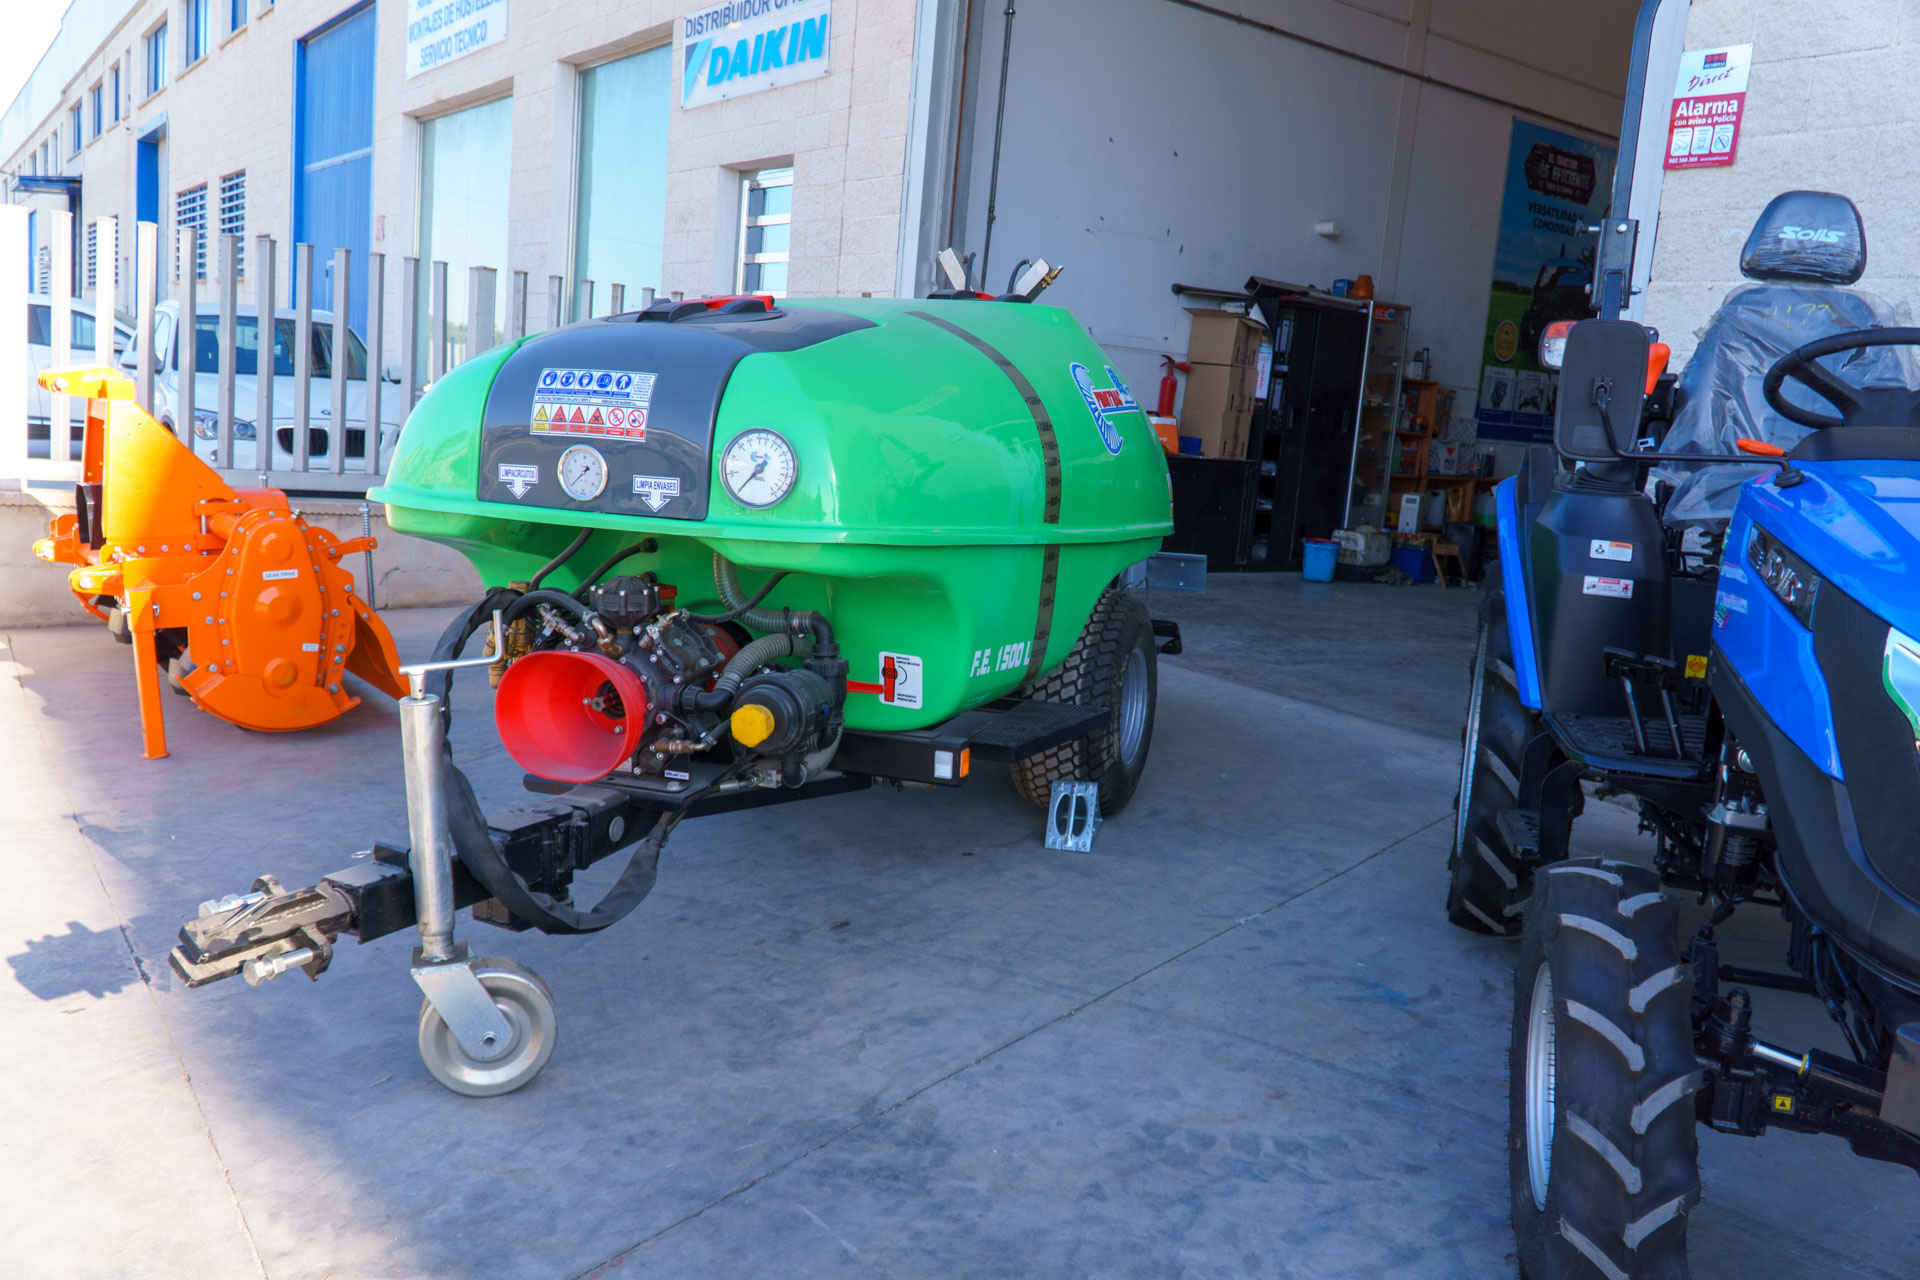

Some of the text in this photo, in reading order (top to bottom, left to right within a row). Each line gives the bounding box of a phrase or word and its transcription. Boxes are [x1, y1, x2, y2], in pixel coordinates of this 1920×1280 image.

[409, 8, 443, 44] MONTAJES
[444, 2, 454, 26] DE
[686, 0, 770, 39] DISTRIBUIDOR
[420, 19, 487, 68] SERVICIO TECNICO
[707, 13, 828, 87] DAIKIN
[1687, 65, 1738, 92] Direct
[1676, 98, 1739, 118] Alarma
[1674, 119, 1687, 127] con
[1688, 116, 1706, 126] aviso
[1528, 201, 1577, 222] VERSATILIDAD
[1533, 218, 1576, 236] COMODIDAD
[502, 468, 535, 479] LIMPIACIRCUITOS
[636, 480, 677, 492] LIMPIA ENVASES
[995, 641, 1025, 672] 1500
